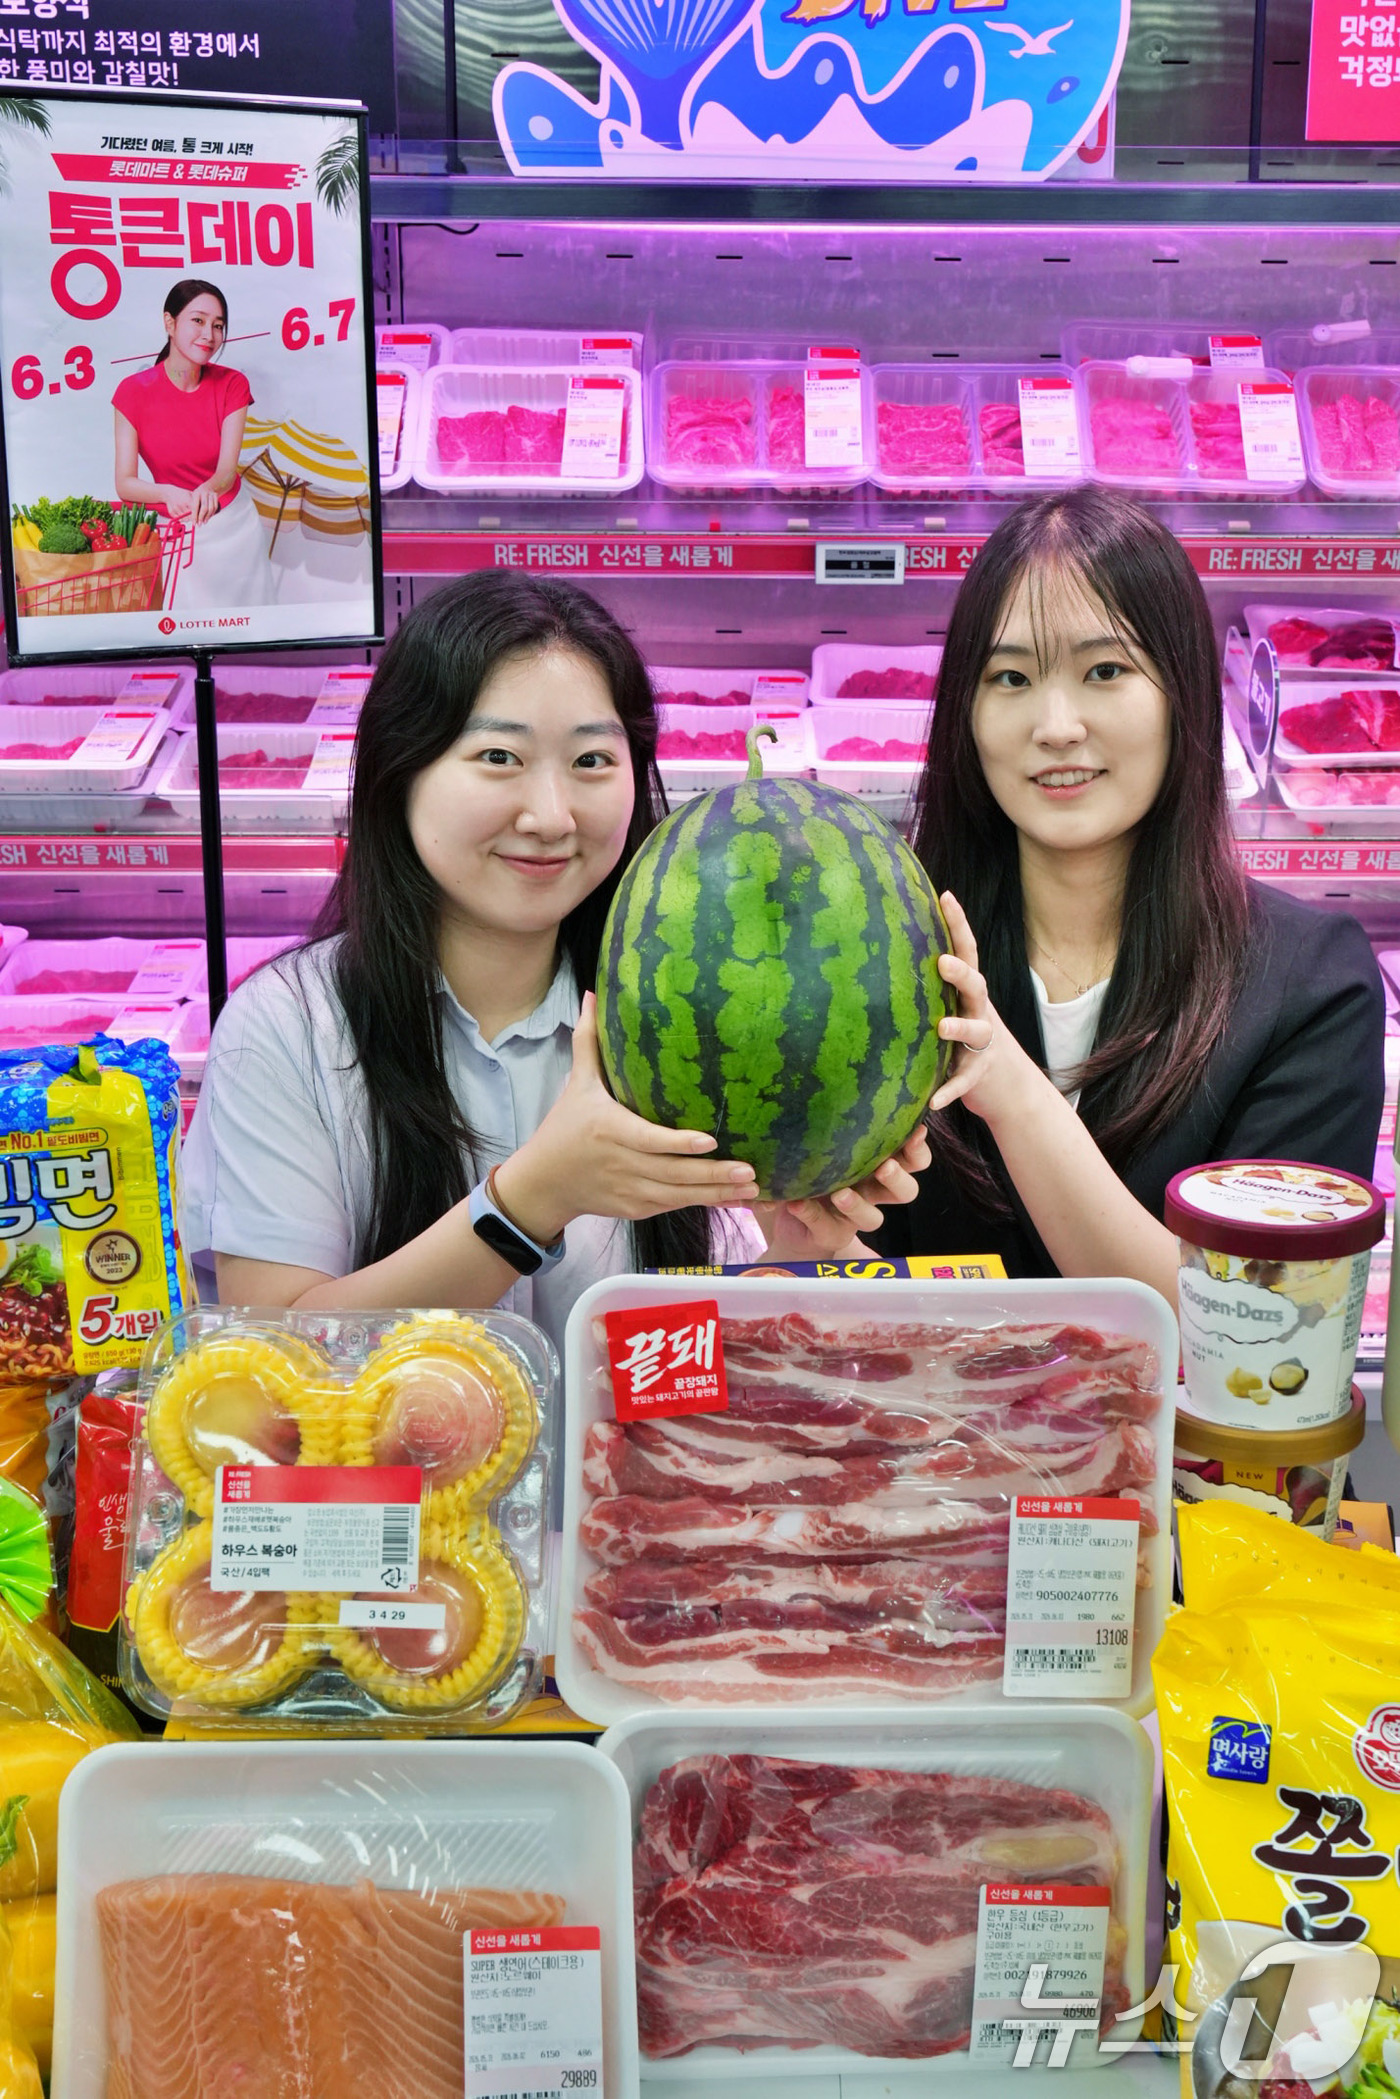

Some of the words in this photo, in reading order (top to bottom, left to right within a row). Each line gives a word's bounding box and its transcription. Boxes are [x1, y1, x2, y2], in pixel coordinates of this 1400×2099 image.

[94, 30, 162, 57] 최적의
[168, 31, 260, 58] 환경에서
[26, 60, 96, 84] 풍미와
[101, 61, 179, 86] 감칠맛!
[100, 136, 148, 151] 기다렸던
[151, 138, 177, 153] 여름,
[182, 137, 197, 153] 통
[200, 141, 223, 154] 크게
[227, 142, 253, 156] 시작!
[109, 160, 171, 178] 롯데마트
[173, 163, 184, 179] &
[187, 164, 248, 182] 롯데슈퍼
[48, 190, 314, 320] 통큰데이
[281, 298, 356, 350] 6.7
[11, 345, 96, 400] 6.3
[598, 545, 664, 567] 신선을
[669, 545, 733, 567] 새롭게
[1312, 548, 1377, 571] 신선을
[180, 619, 216, 630] LOTTE
[218, 617, 250, 628] MART
[37, 845, 101, 865] 신선을
[106, 845, 169, 865] 새롭게
[1298, 850, 1361, 871] 신선을
[10, 1130, 43, 1150] No.1
[95, 1252, 131, 1264] WINNER
[614, 1319, 717, 1394] 끝돼
[674, 1374, 718, 1390] 끝장돼지
[631, 1394, 655, 1405] 맛있는
[655, 1389, 694, 1402] 돼지고기의
[1236, 1471, 1265, 1480] NEW
[1020, 1501, 1051, 1513] 신선을
[1052, 1502, 1083, 1513] 새롭게
[221, 1543, 259, 1557] 하우스
[261, 1543, 298, 1557] 복숭아
[1036, 1590, 1119, 1602] 905002407776
[1096, 1628, 1129, 1646] 13108
[1211, 1738, 1269, 1774] 면사랑
[990, 1889, 1020, 1900] 신선을
[1023, 1890, 1053, 1900] 새롭게
[987, 1909, 1005, 1921] 한우
[474, 1934, 507, 1948] 신선을
[509, 1933, 541, 1946] 새롭게
[471, 1959, 495, 1972] SUPER
[561, 2069, 597, 2089] 29889
